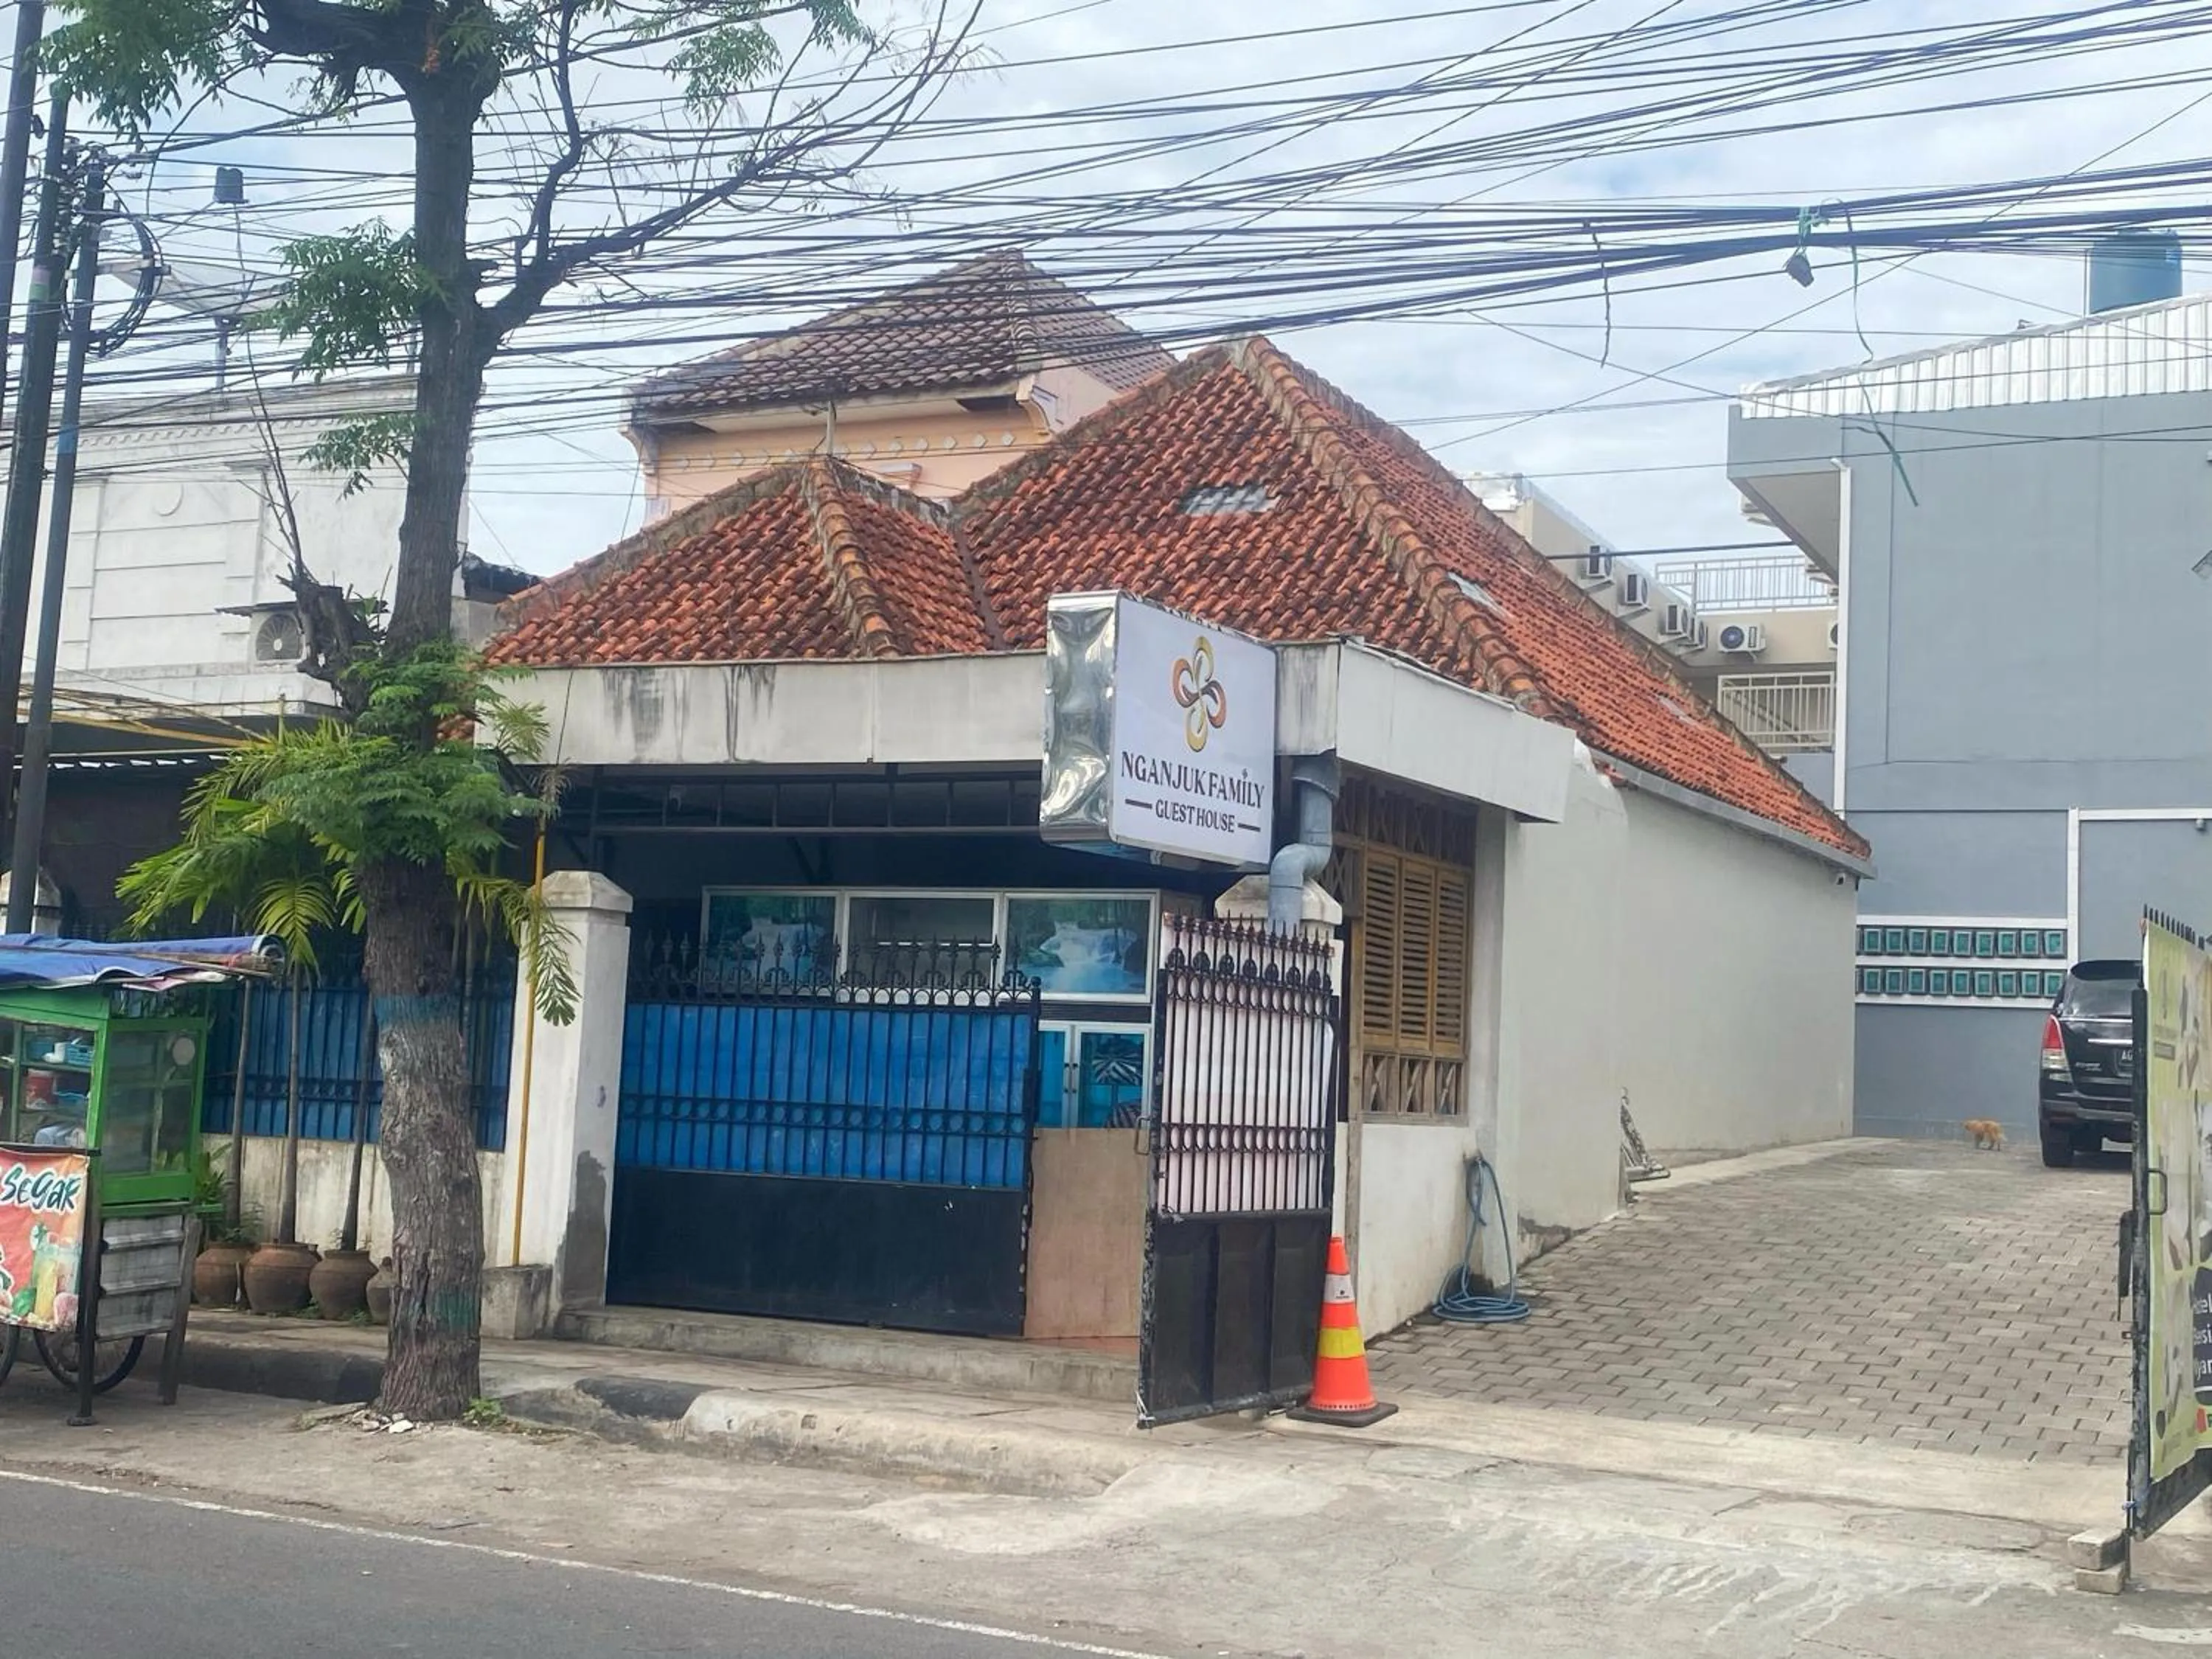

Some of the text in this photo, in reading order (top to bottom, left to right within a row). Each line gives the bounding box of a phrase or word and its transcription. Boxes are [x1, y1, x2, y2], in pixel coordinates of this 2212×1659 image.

[1121, 751, 1206, 796] NGANJUK
[1155, 799, 1236, 833] GUEST HOUSE
